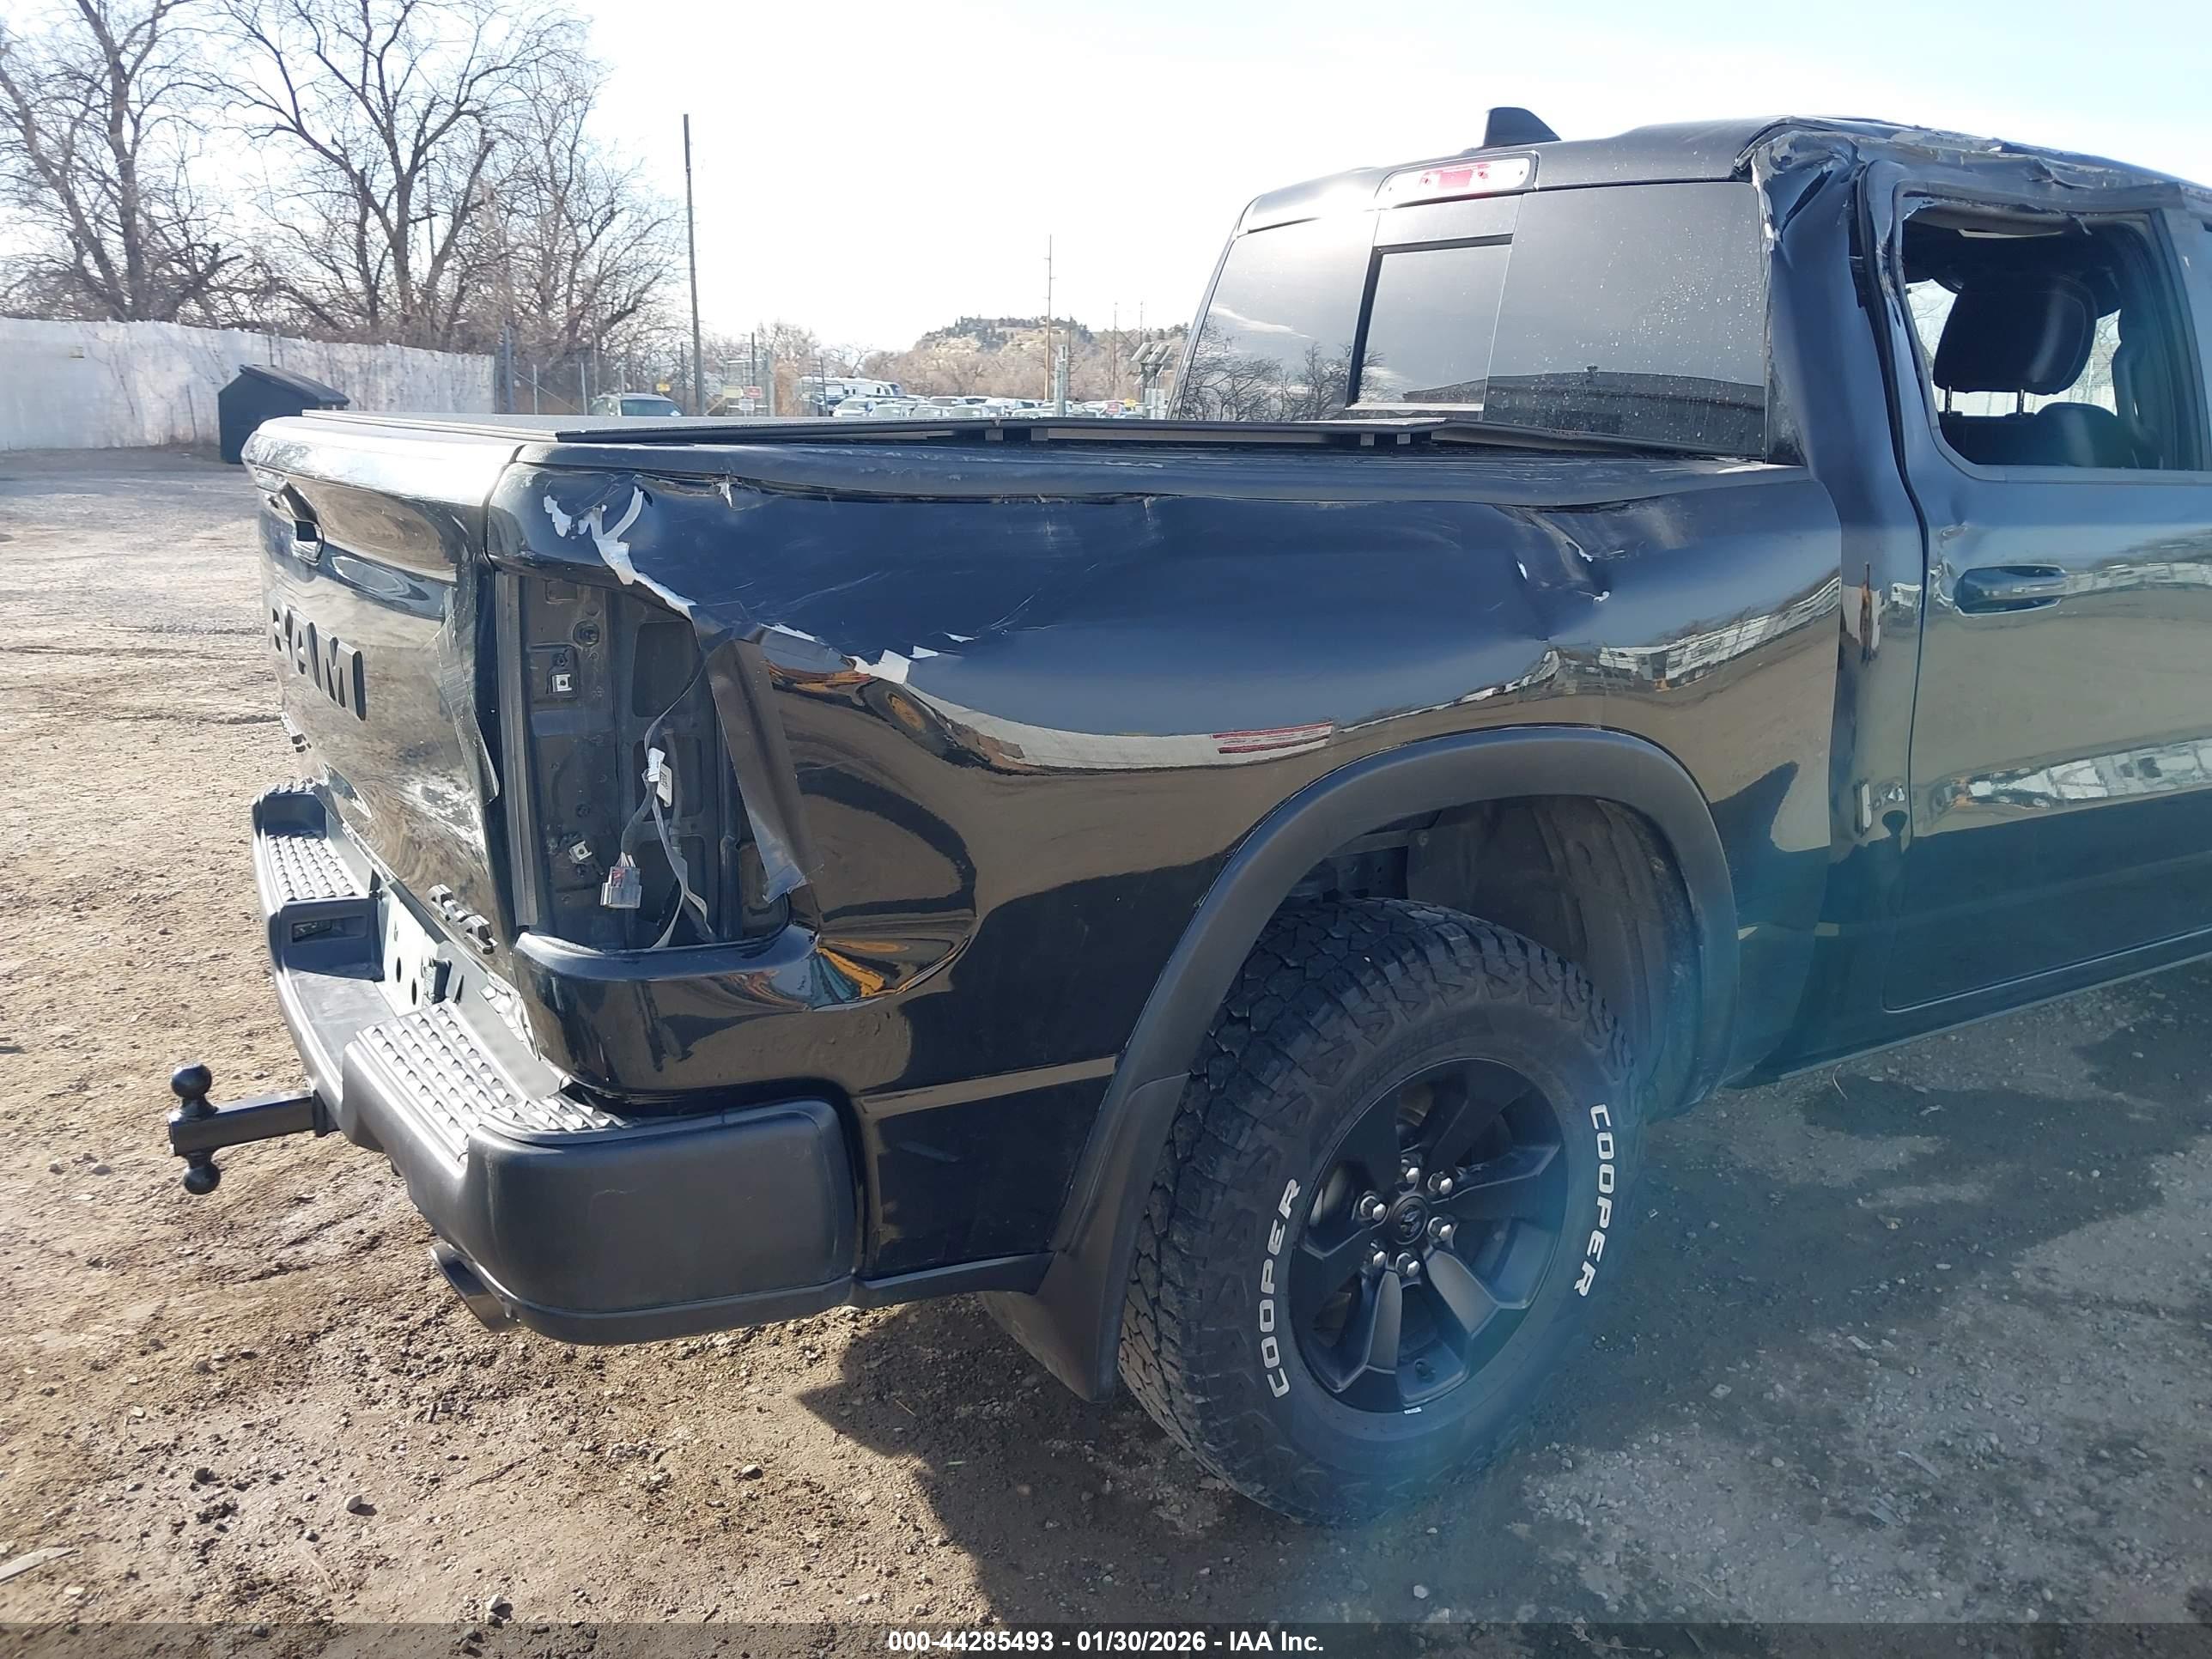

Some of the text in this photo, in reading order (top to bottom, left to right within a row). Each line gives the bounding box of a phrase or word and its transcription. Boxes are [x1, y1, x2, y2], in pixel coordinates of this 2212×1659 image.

[267, 587, 367, 721] RAM
[1259, 1178, 1301, 1398] COOPER
[1574, 1103, 1614, 1297] COOPER
